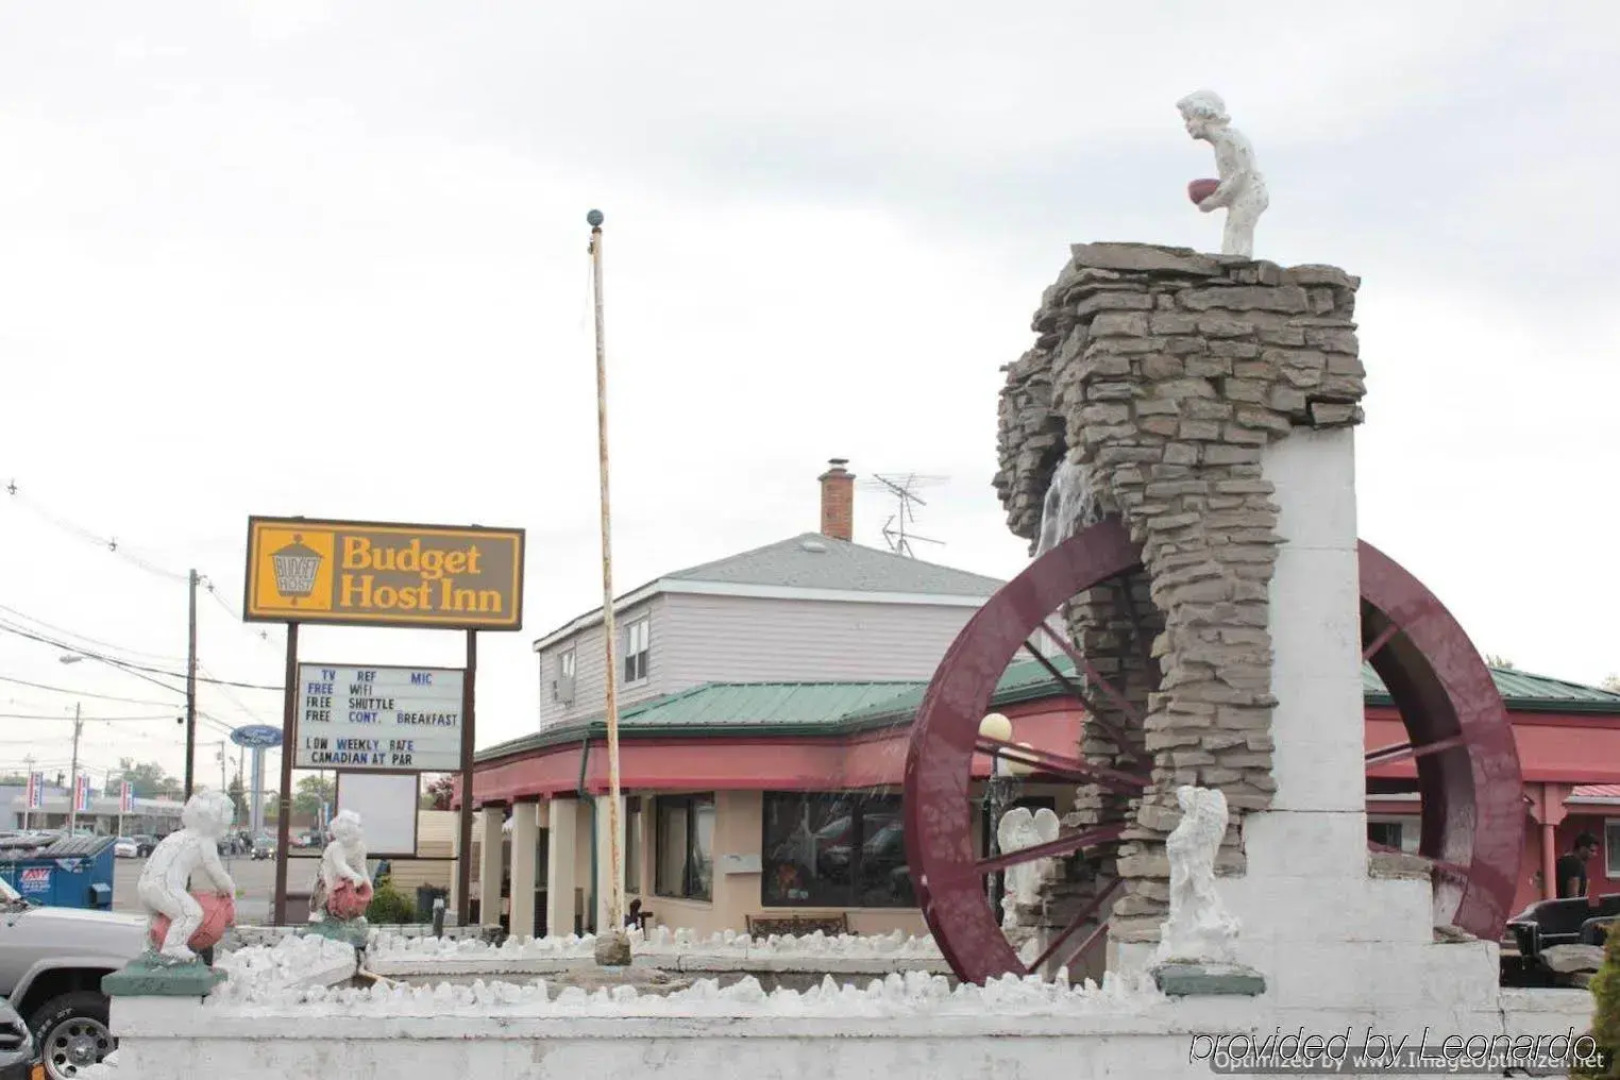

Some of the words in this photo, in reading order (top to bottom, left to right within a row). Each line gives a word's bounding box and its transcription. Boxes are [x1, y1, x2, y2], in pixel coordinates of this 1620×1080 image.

[341, 537, 482, 579] Budget
[276, 556, 318, 578] BUDGET
[279, 577, 312, 592] HOST
[340, 575, 433, 609] Host
[441, 578, 502, 612] Inn
[321, 669, 336, 681] TV
[357, 671, 376, 682] REF
[411, 672, 432, 685] MIC
[308, 683, 334, 694] FREE
[350, 684, 372, 695] WIFI
[306, 696, 331, 708] FREE
[349, 698, 394, 710] SHUTTLE
[306, 710, 330, 721] FREE
[349, 712, 382, 724] CONT.
[397, 712, 458, 726] BREAKFAST
[306, 738, 328, 749] LOW
[337, 739, 379, 750] WEEKLY
[390, 740, 413, 751] RATE
[311, 752, 367, 764] CANADIAN
[372, 753, 386, 764] AT
[392, 754, 413, 765] PAR
